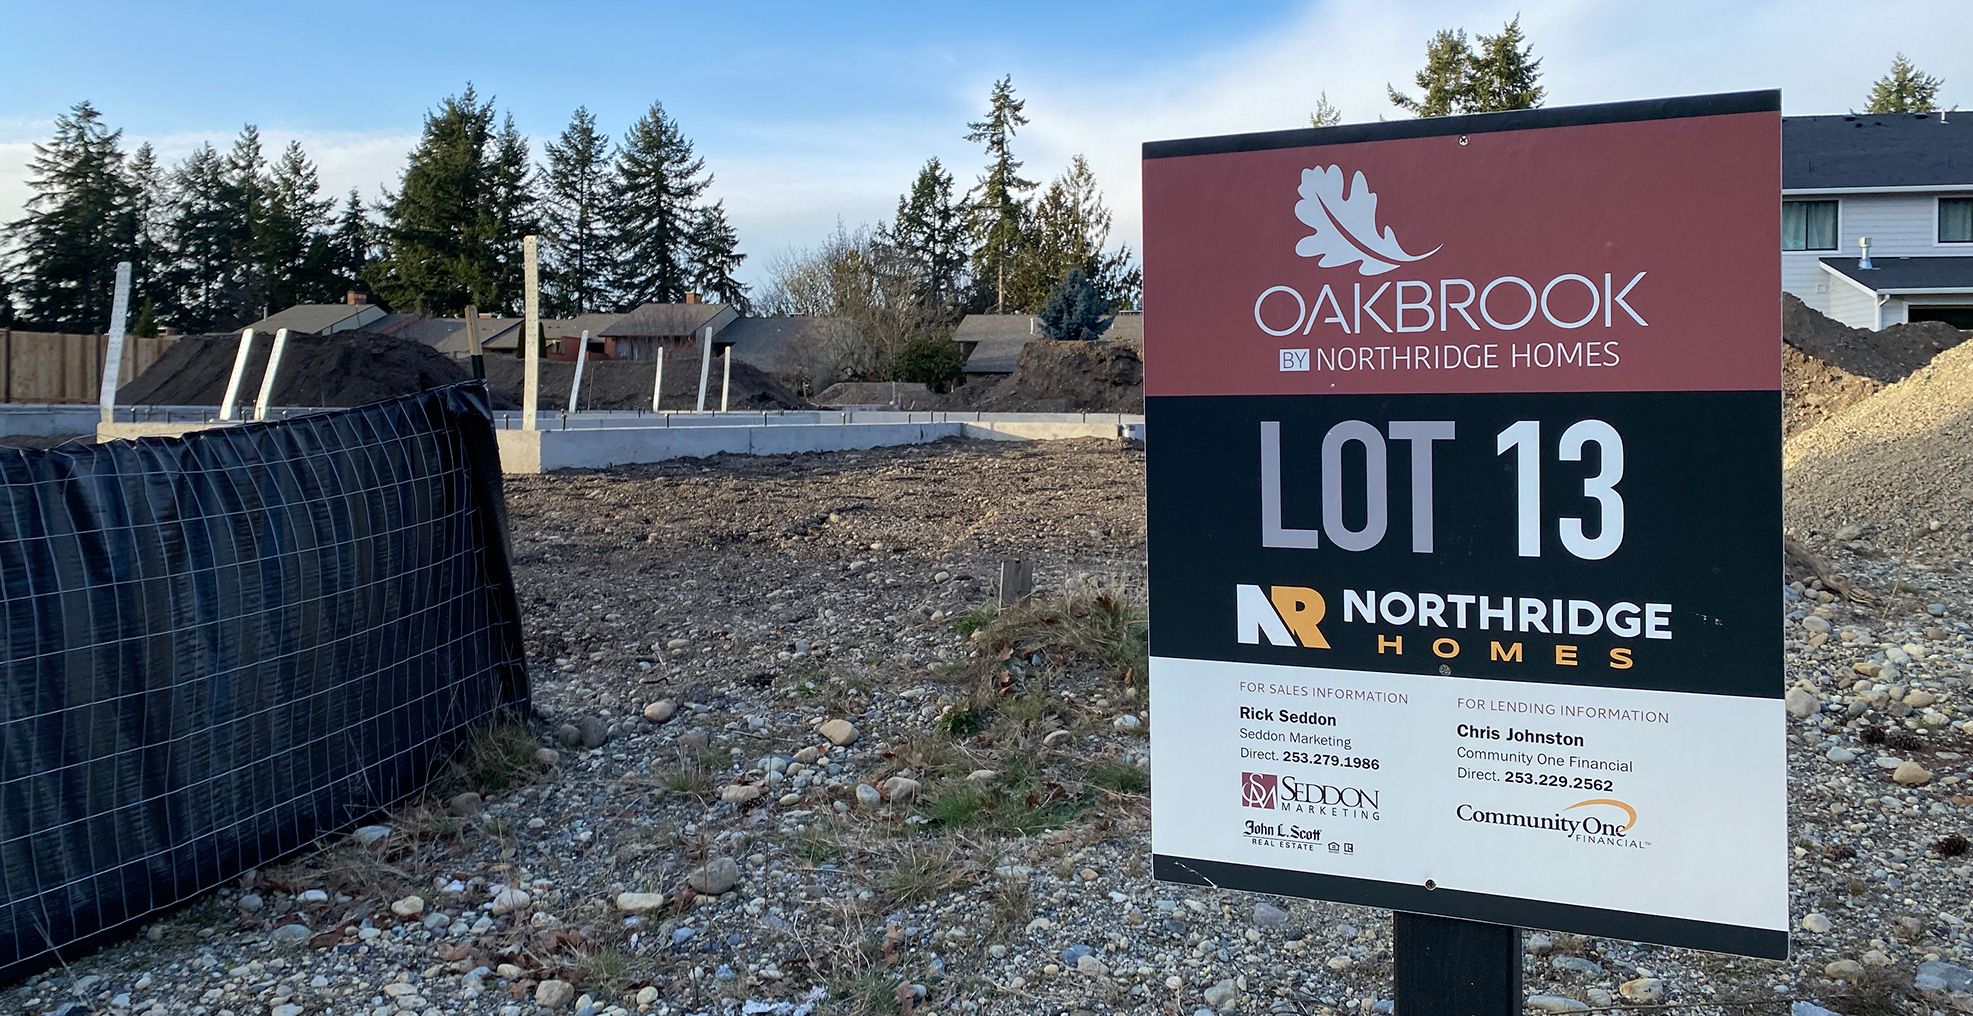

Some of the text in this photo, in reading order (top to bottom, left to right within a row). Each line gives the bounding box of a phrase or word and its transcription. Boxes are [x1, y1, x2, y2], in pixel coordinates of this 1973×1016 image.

[1254, 272, 1649, 337] OAKBROOK
[1283, 341, 1620, 371] BY NORTHRIDGE HOMES
[1260, 419, 1624, 560] LOT 13
[1343, 589, 1673, 640] NORTHRIDGE
[1378, 634, 1633, 669] HOMES
[1239, 681, 1409, 705] FOR SALES INFORMATION
[1239, 706, 1337, 727] Rick Seddon
[1457, 697, 1670, 724] FOR LENDING INFORMATION
[1239, 727, 1352, 751] Seddon Marketing
[1457, 723, 1585, 747] Chris Johnston
[1240, 747, 1380, 771] Direct. 253.279.1986
[1456, 746, 1633, 773] Community One Financial
[1457, 766, 1614, 792] Direct. 253.229.2562
[1281, 775, 1379, 810] SEDDON
[1281, 802, 1380, 821] MARKETING
[1243, 820, 1274, 836] John
[1290, 825, 1321, 841] Scott
[1251, 838, 1314, 852] REAL ESTATE
